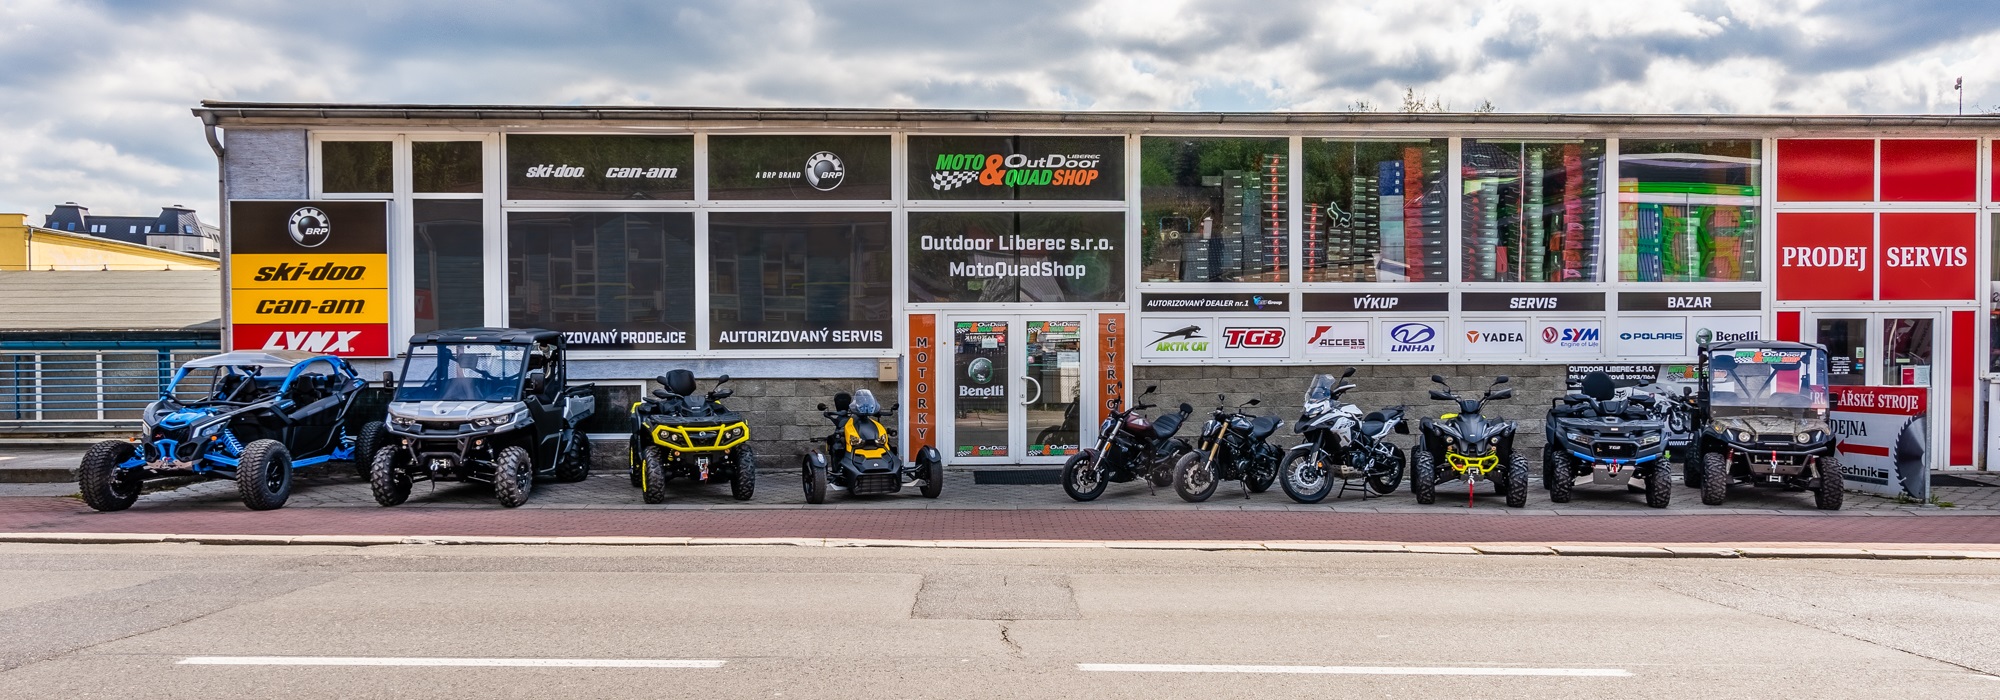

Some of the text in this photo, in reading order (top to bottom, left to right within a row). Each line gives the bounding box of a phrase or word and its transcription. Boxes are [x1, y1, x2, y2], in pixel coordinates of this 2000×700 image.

[1004, 154, 1100, 168] OutDoor
[526, 164, 585, 178] ski-doo
[605, 166, 678, 179] can-am
[755, 171, 801, 179] A BRP BRAND
[820, 171, 843, 179] BRP
[936, 154, 1006, 186] MOTO &
[1005, 169, 1099, 187] QUAD SHOP
[305, 227, 329, 235] BRP
[921, 235, 1114, 251] Outdoor Liberec s.r.o.
[1782, 246, 1867, 271] PRODEJ
[1887, 246, 1967, 267] SERVIS
[254, 262, 366, 281] ski-doo
[950, 261, 1086, 279] MotoQuadShop
[255, 299, 365, 314] can-am
[1147, 299, 1205, 307] AUTORIZOVANÝ
[1353, 294, 1399, 309] VÝKUP
[1509, 297, 1558, 309] SERVIS
[1667, 296, 1712, 308] BAZAR
[261, 331, 362, 352] LYNX
[562, 328, 686, 344] ZOVANÝ PRODEJCE
[719, 326, 883, 343] AUTORIZOVANÝ SERVIS
[1223, 328, 1285, 348] TGB
[1482, 333, 1524, 342] YADEA
[1561, 328, 1599, 341] SYM
[1716, 330, 1759, 341] Benelli
[1156, 341, 1210, 352] ARCTIC CAT
[1319, 338, 1366, 346] ACCESS
[1390, 344, 1436, 352] LINHAI
[917, 337, 928, 440] MOTORKY
[959, 385, 1004, 397] Benelli
[1878, 394, 1919, 412] STROJE
[1830, 418, 1867, 438] DEJNA
[1840, 464, 1878, 478] echnik
